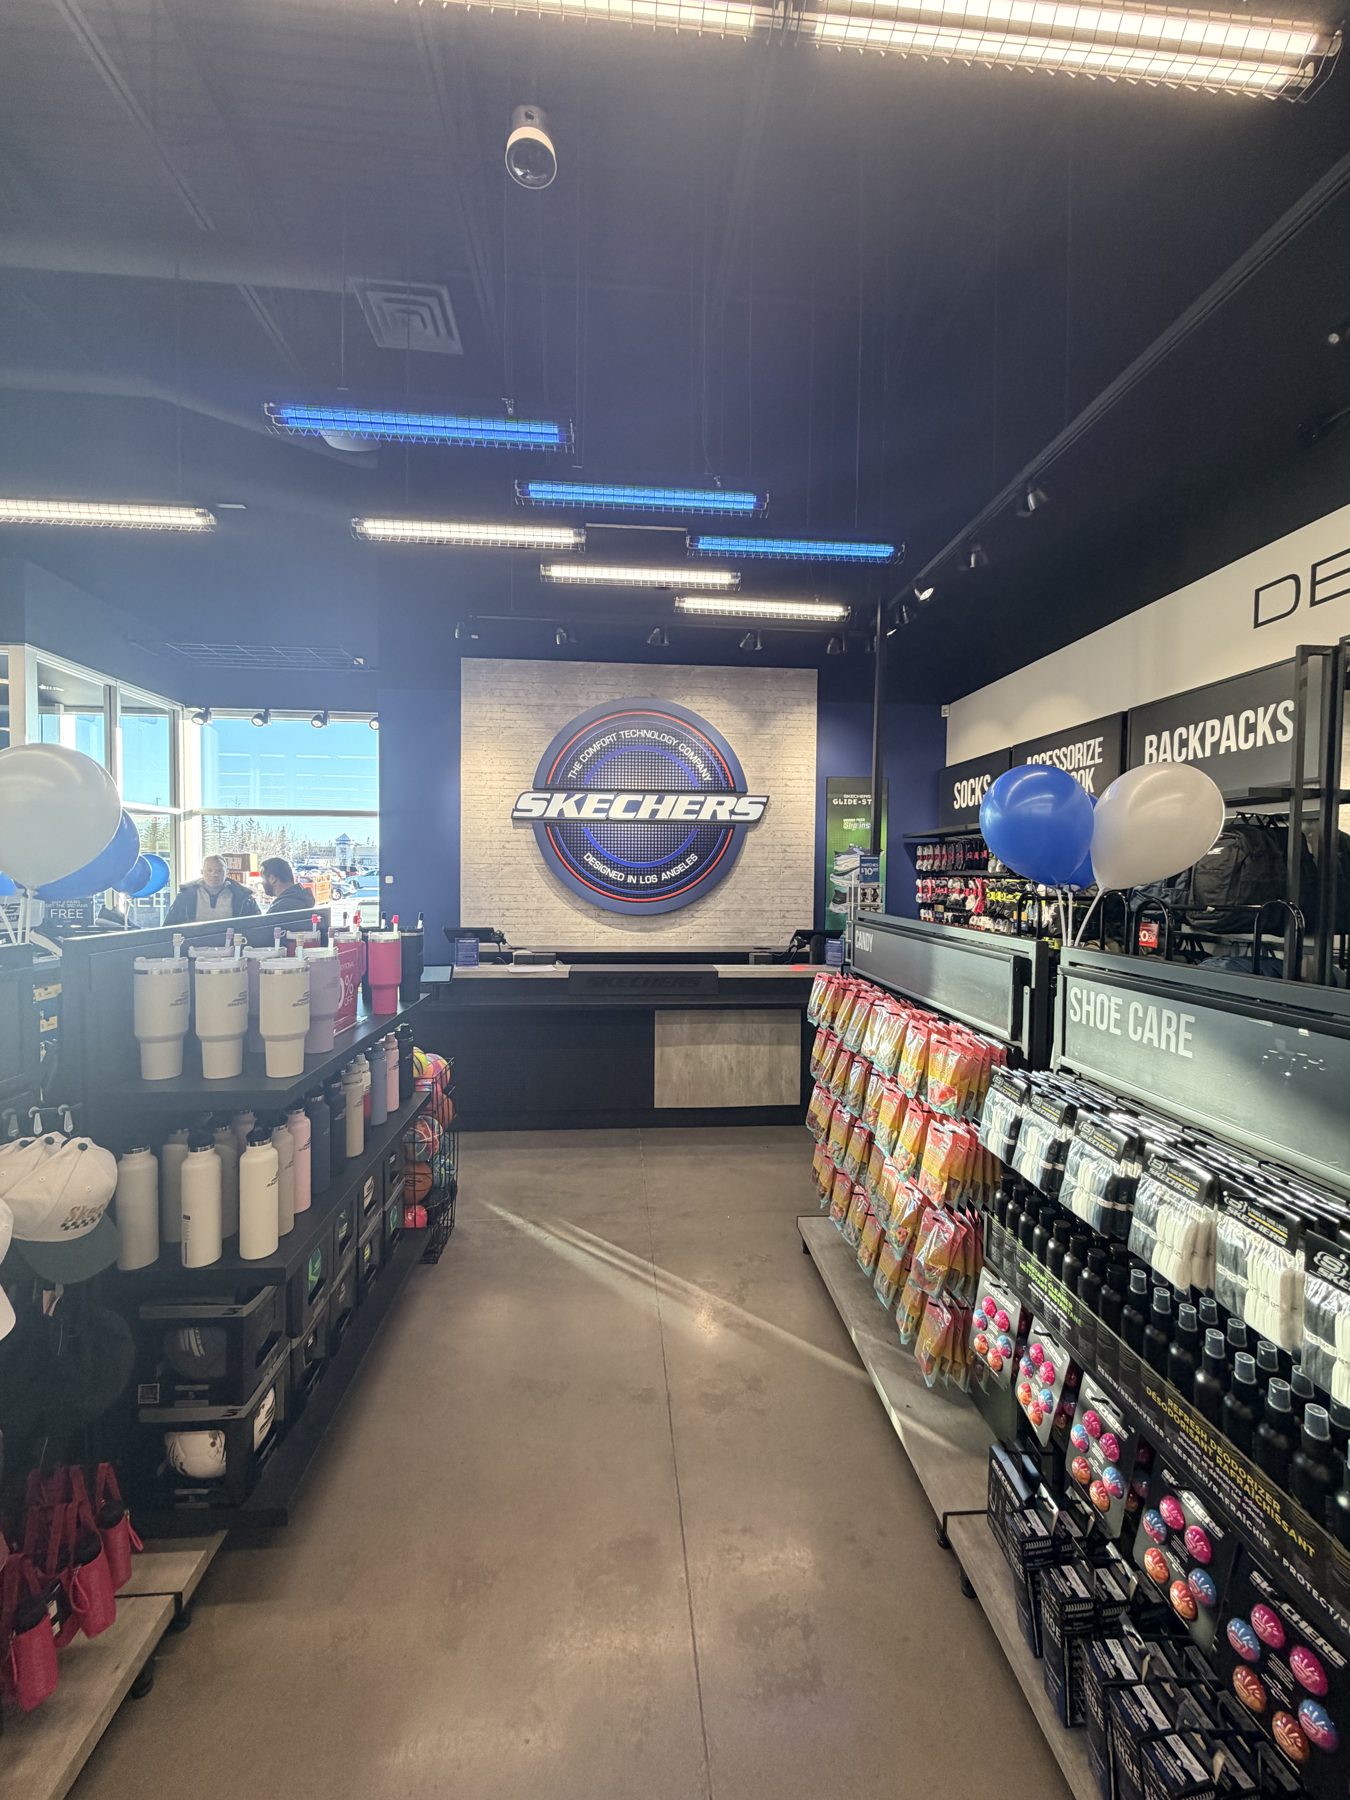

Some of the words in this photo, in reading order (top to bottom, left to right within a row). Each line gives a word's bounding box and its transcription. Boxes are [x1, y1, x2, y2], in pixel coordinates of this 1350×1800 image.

[1144, 700, 1295, 765] BACKPACKS
[568, 761, 583, 779] THE
[580, 732, 618, 763] COMFORT
[619, 729, 679, 746] TECHNOLOGY
[678, 743, 713, 782] COMPANY
[513, 792, 768, 821] SKECHERS
[953, 774, 991, 809] SOCKS
[583, 852, 624, 882] DESIGNED
[627, 873, 637, 884] IN
[640, 874, 658, 884] LOS
[661, 853, 698, 881] ANGELES
[50, 908, 84, 919] FREE
[855, 930, 874, 953] CANDY
[1069, 986, 1123, 1036] SHOE
[1128, 1001, 1196, 1059] CARE
[1080, 1132, 1116, 1158] SKECHERS
[1148, 1168, 1197, 1199] SKECHERS
[1226, 1205, 1288, 1246] SKECHERS
[1317, 1266, 1350, 1291] SKE
[1084, 1387, 1130, 1440] SCHERS
[1167, 1397, 1208, 1442] REFRESH
[1210, 1438, 1281, 1513] DEODORIZER
[1161, 1469, 1225, 1538] SKCHERS
[1249, 1570, 1348, 1667] SKCHERS
